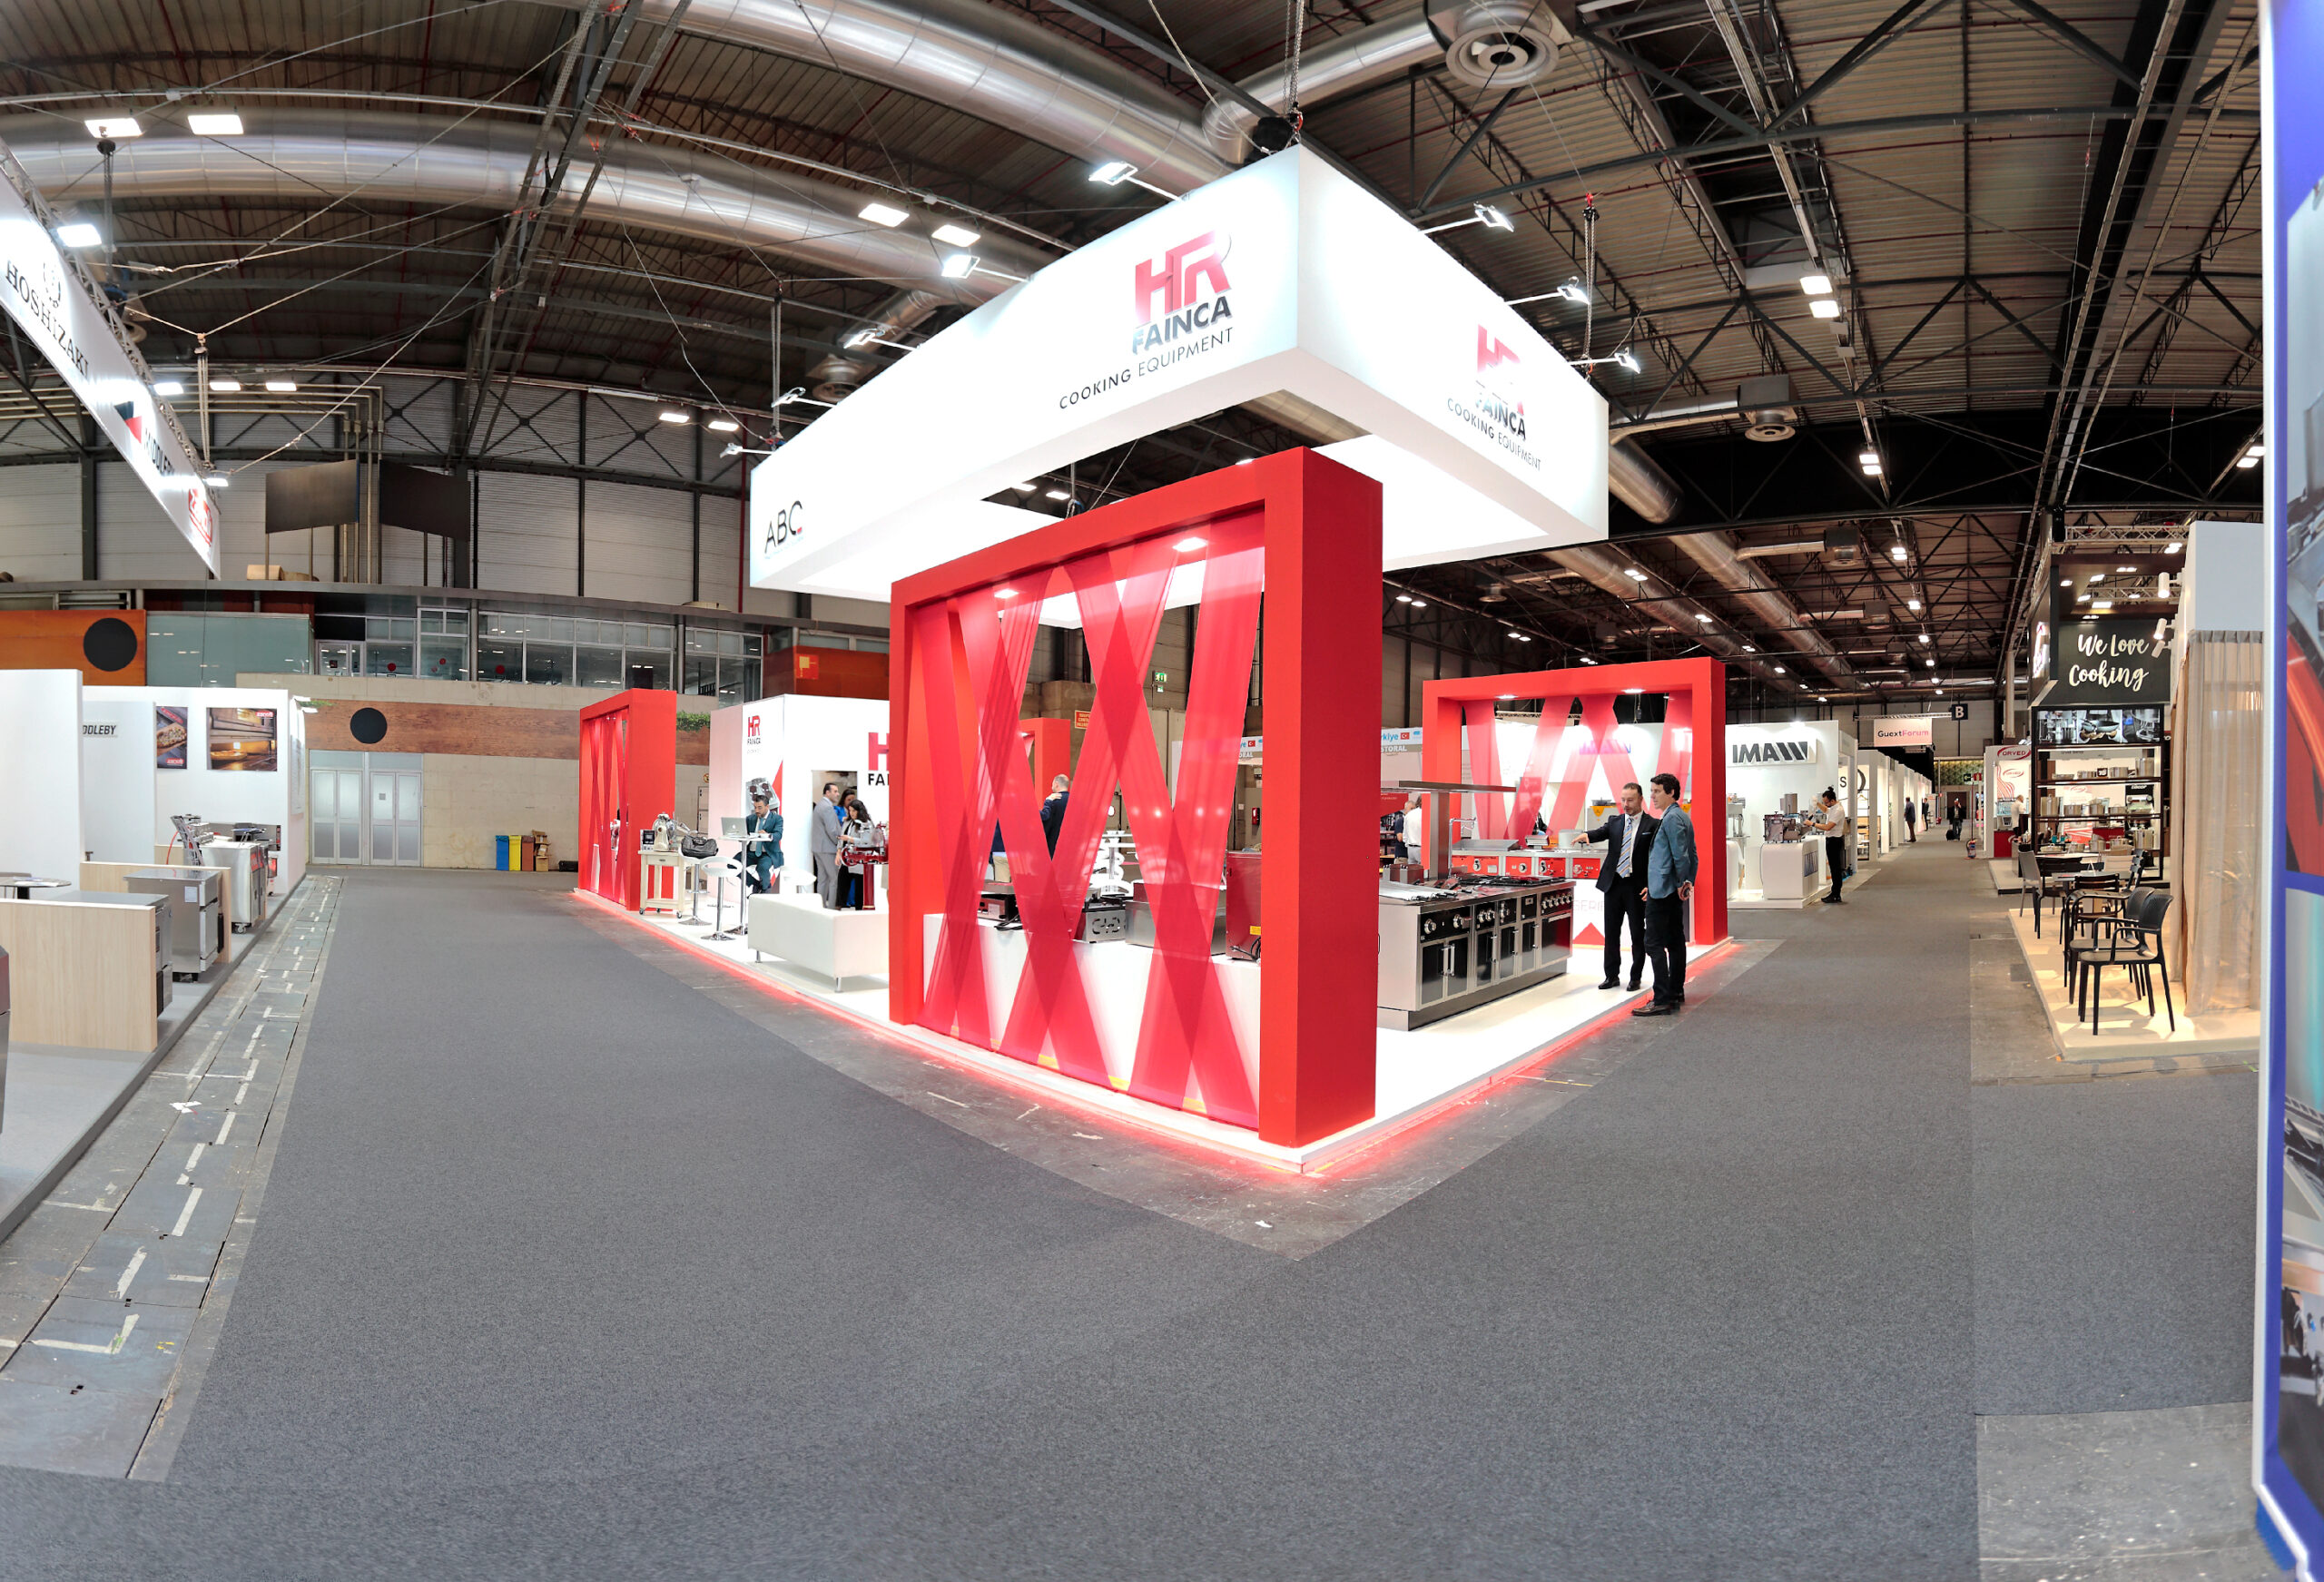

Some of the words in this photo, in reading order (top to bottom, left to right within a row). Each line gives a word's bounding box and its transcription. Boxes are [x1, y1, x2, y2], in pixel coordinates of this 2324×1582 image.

[5, 260, 89, 378] HOSHIZAKI
[1131, 295, 1234, 356] FAINCA
[1059, 368, 1132, 409] COOKING
[1137, 327, 1234, 378] EQUIPMENT
[1447, 398, 1495, 439] COOKING
[1498, 431, 1541, 471] EQUIPMENT
[764, 500, 803, 554] ABC
[2077, 634, 2108, 657] We
[2110, 634, 2150, 657] Love
[2068, 660, 2150, 693] Cooking
[1955, 705, 1965, 719] B
